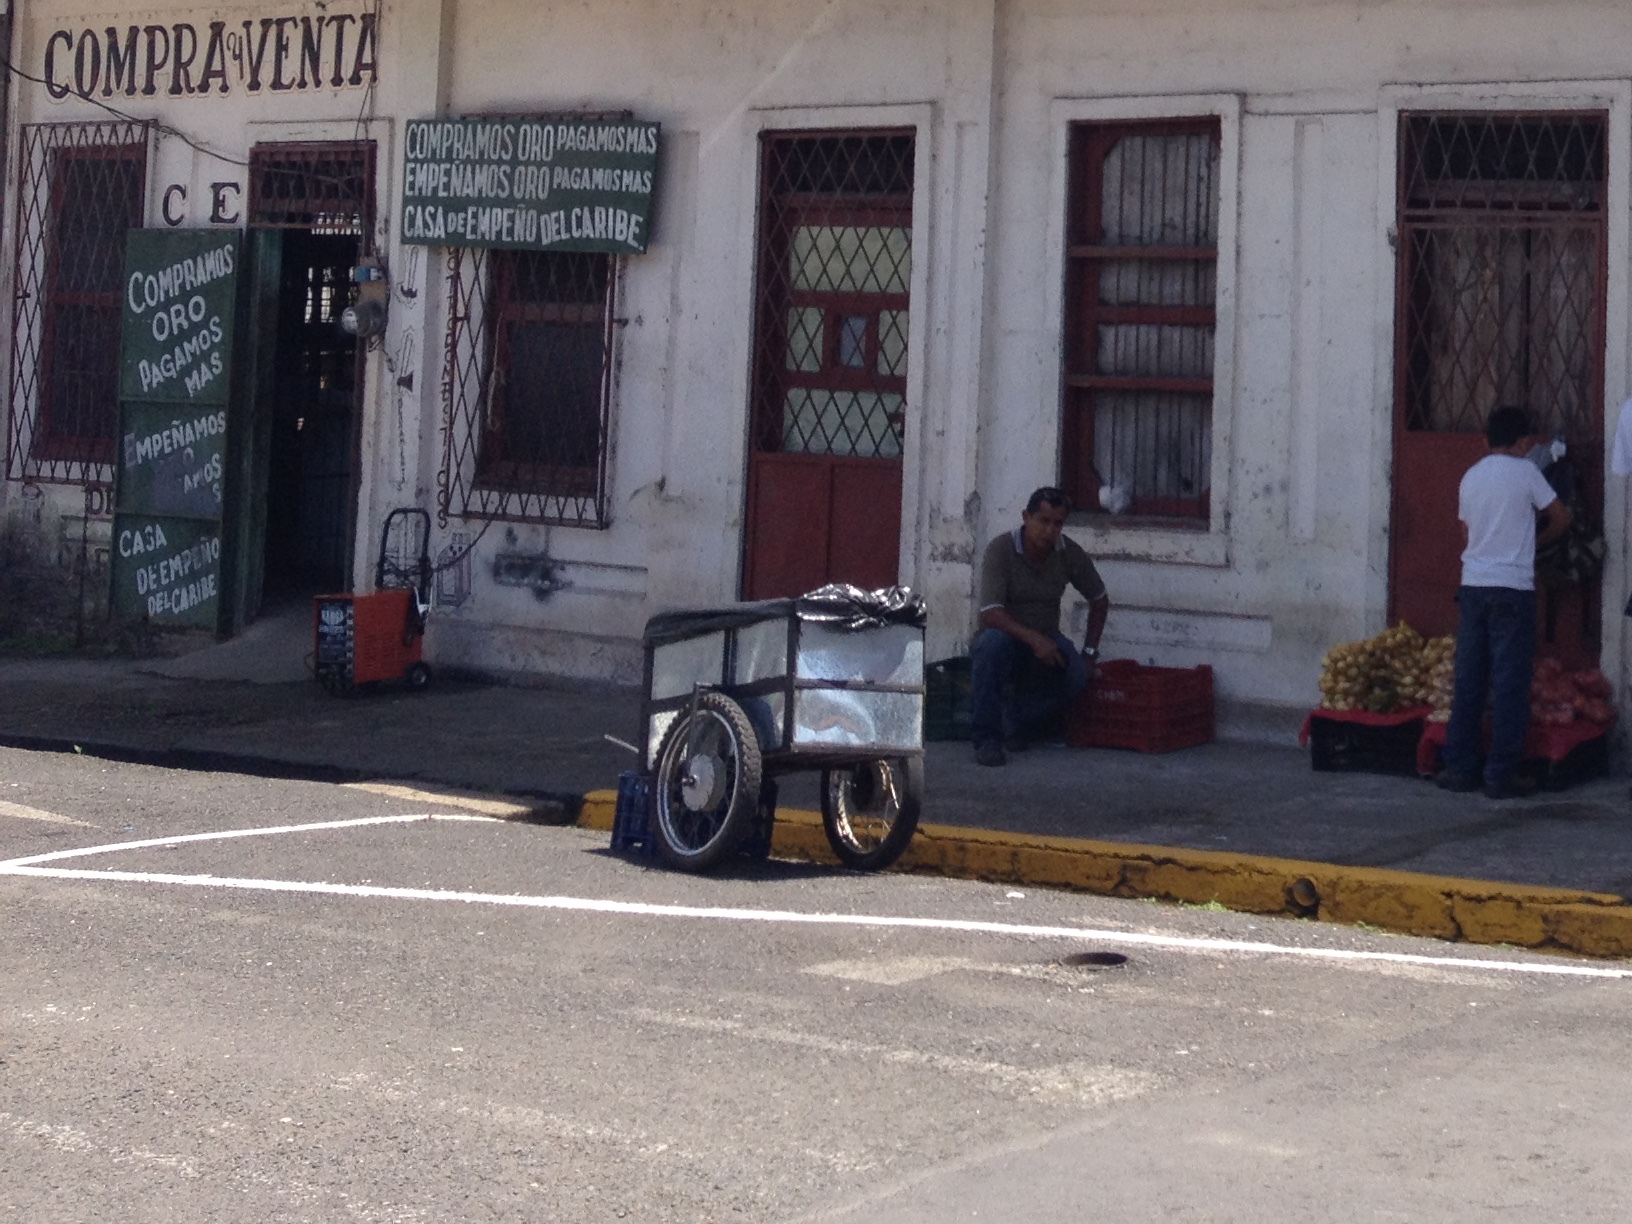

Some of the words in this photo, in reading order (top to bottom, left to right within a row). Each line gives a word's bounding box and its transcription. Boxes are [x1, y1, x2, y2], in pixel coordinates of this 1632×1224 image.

[45, 25, 230, 99] COMPRA
[243, 13, 378, 91] VENTA
[406, 123, 515, 161] COMPRAMOS
[517, 124, 554, 162] ORO
[556, 125, 625, 152] PAGAMOS
[626, 127, 657, 154] MAS
[404, 160, 511, 199] EMPEÑAMOS
[513, 165, 549, 200] ORO
[553, 166, 621, 191] PAGAMOS
[622, 169, 652, 194] MAS
[404, 205, 446, 239] CASA
[447, 211, 466, 234] DE
[466, 203, 538, 242] EMPEÑO
[539, 209, 573, 246] DEL
[128, 244, 234, 314] COMPRAMOS
[152, 295, 206, 342] ORO
[138, 316, 223, 393] PAGAMOS
[184, 352, 223, 398] MAS
[124, 410, 226, 469] EMPEÑAMOS
[119, 523, 167, 558] CASA
[136, 564, 158, 595] DE
[159, 536, 220, 586] EMPEÑO
[147, 591, 172, 617] DEL
[171, 573, 217, 615] CARIBE
